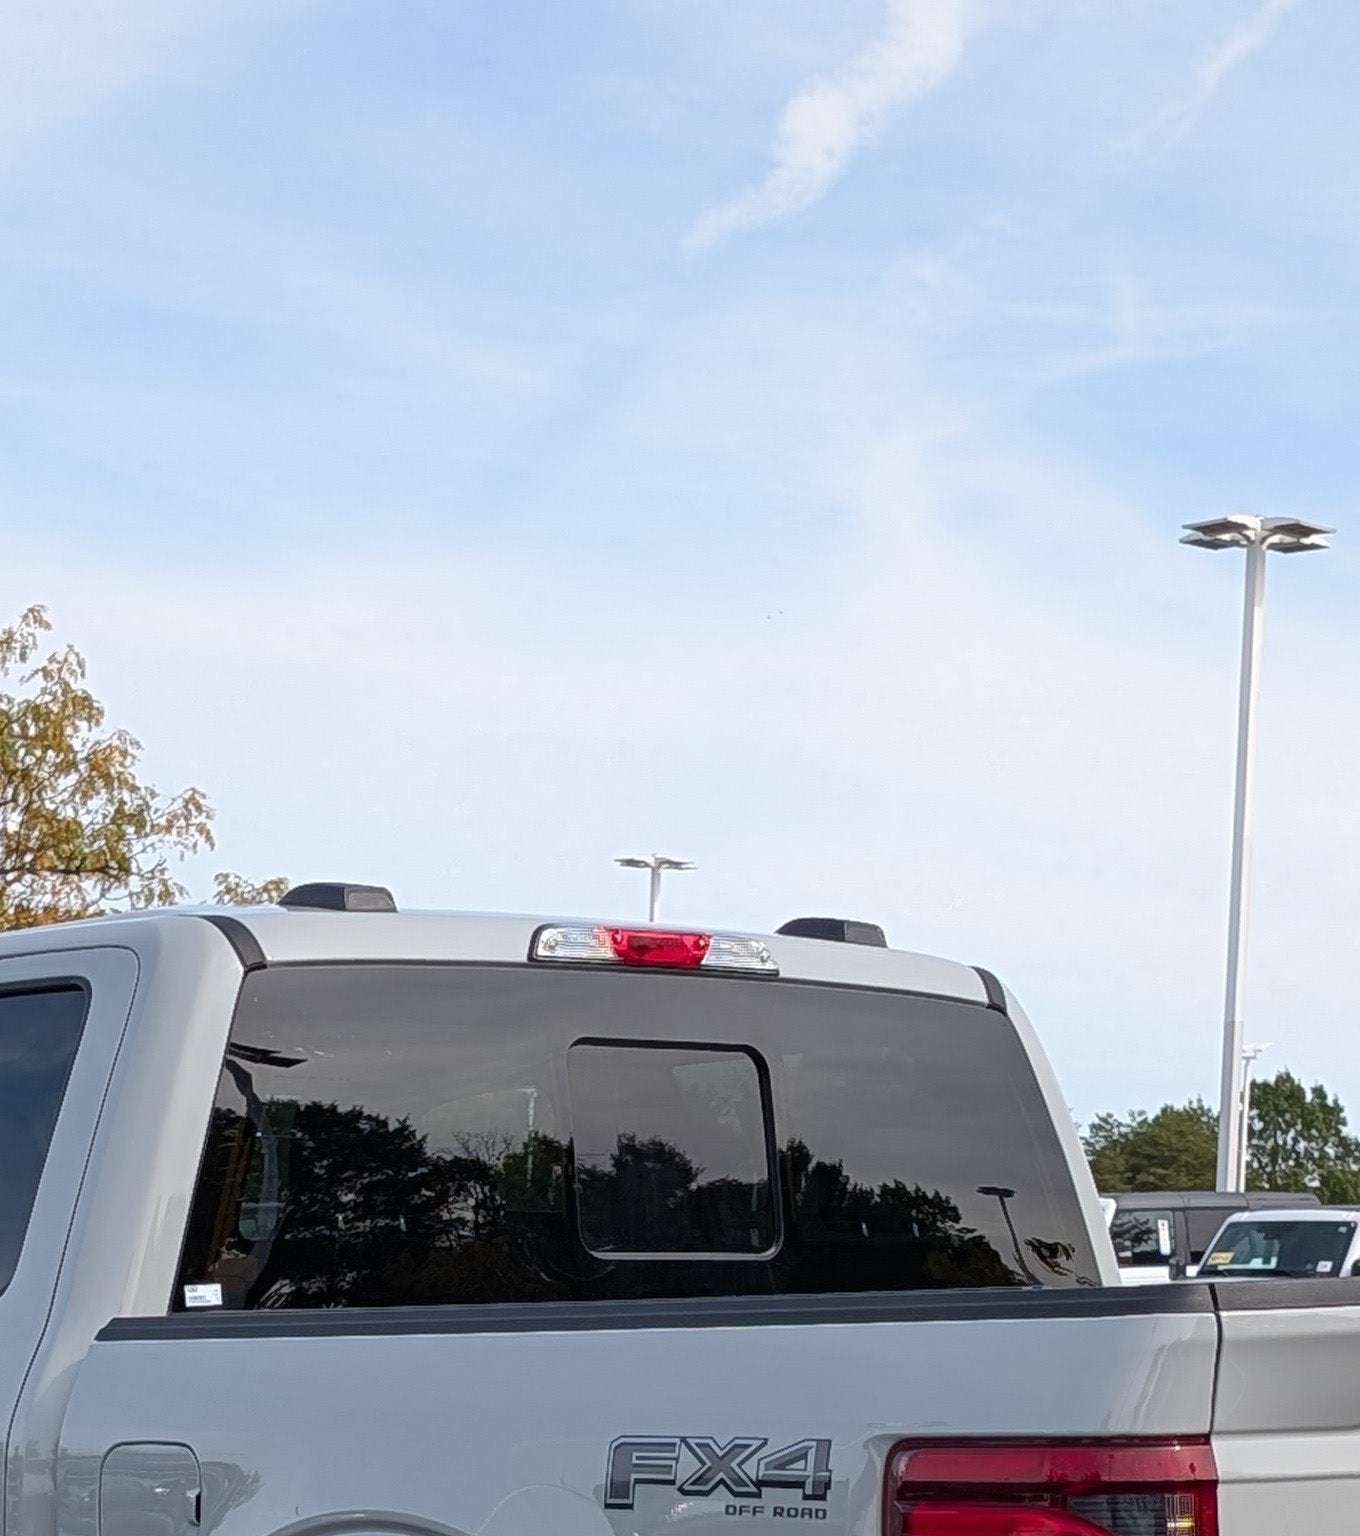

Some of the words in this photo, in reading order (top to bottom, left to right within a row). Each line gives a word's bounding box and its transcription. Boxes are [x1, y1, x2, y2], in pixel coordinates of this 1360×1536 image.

[604, 1435, 832, 1510] FX4
[724, 1503, 765, 1517] OFF
[772, 1505, 828, 1520] ROAD
